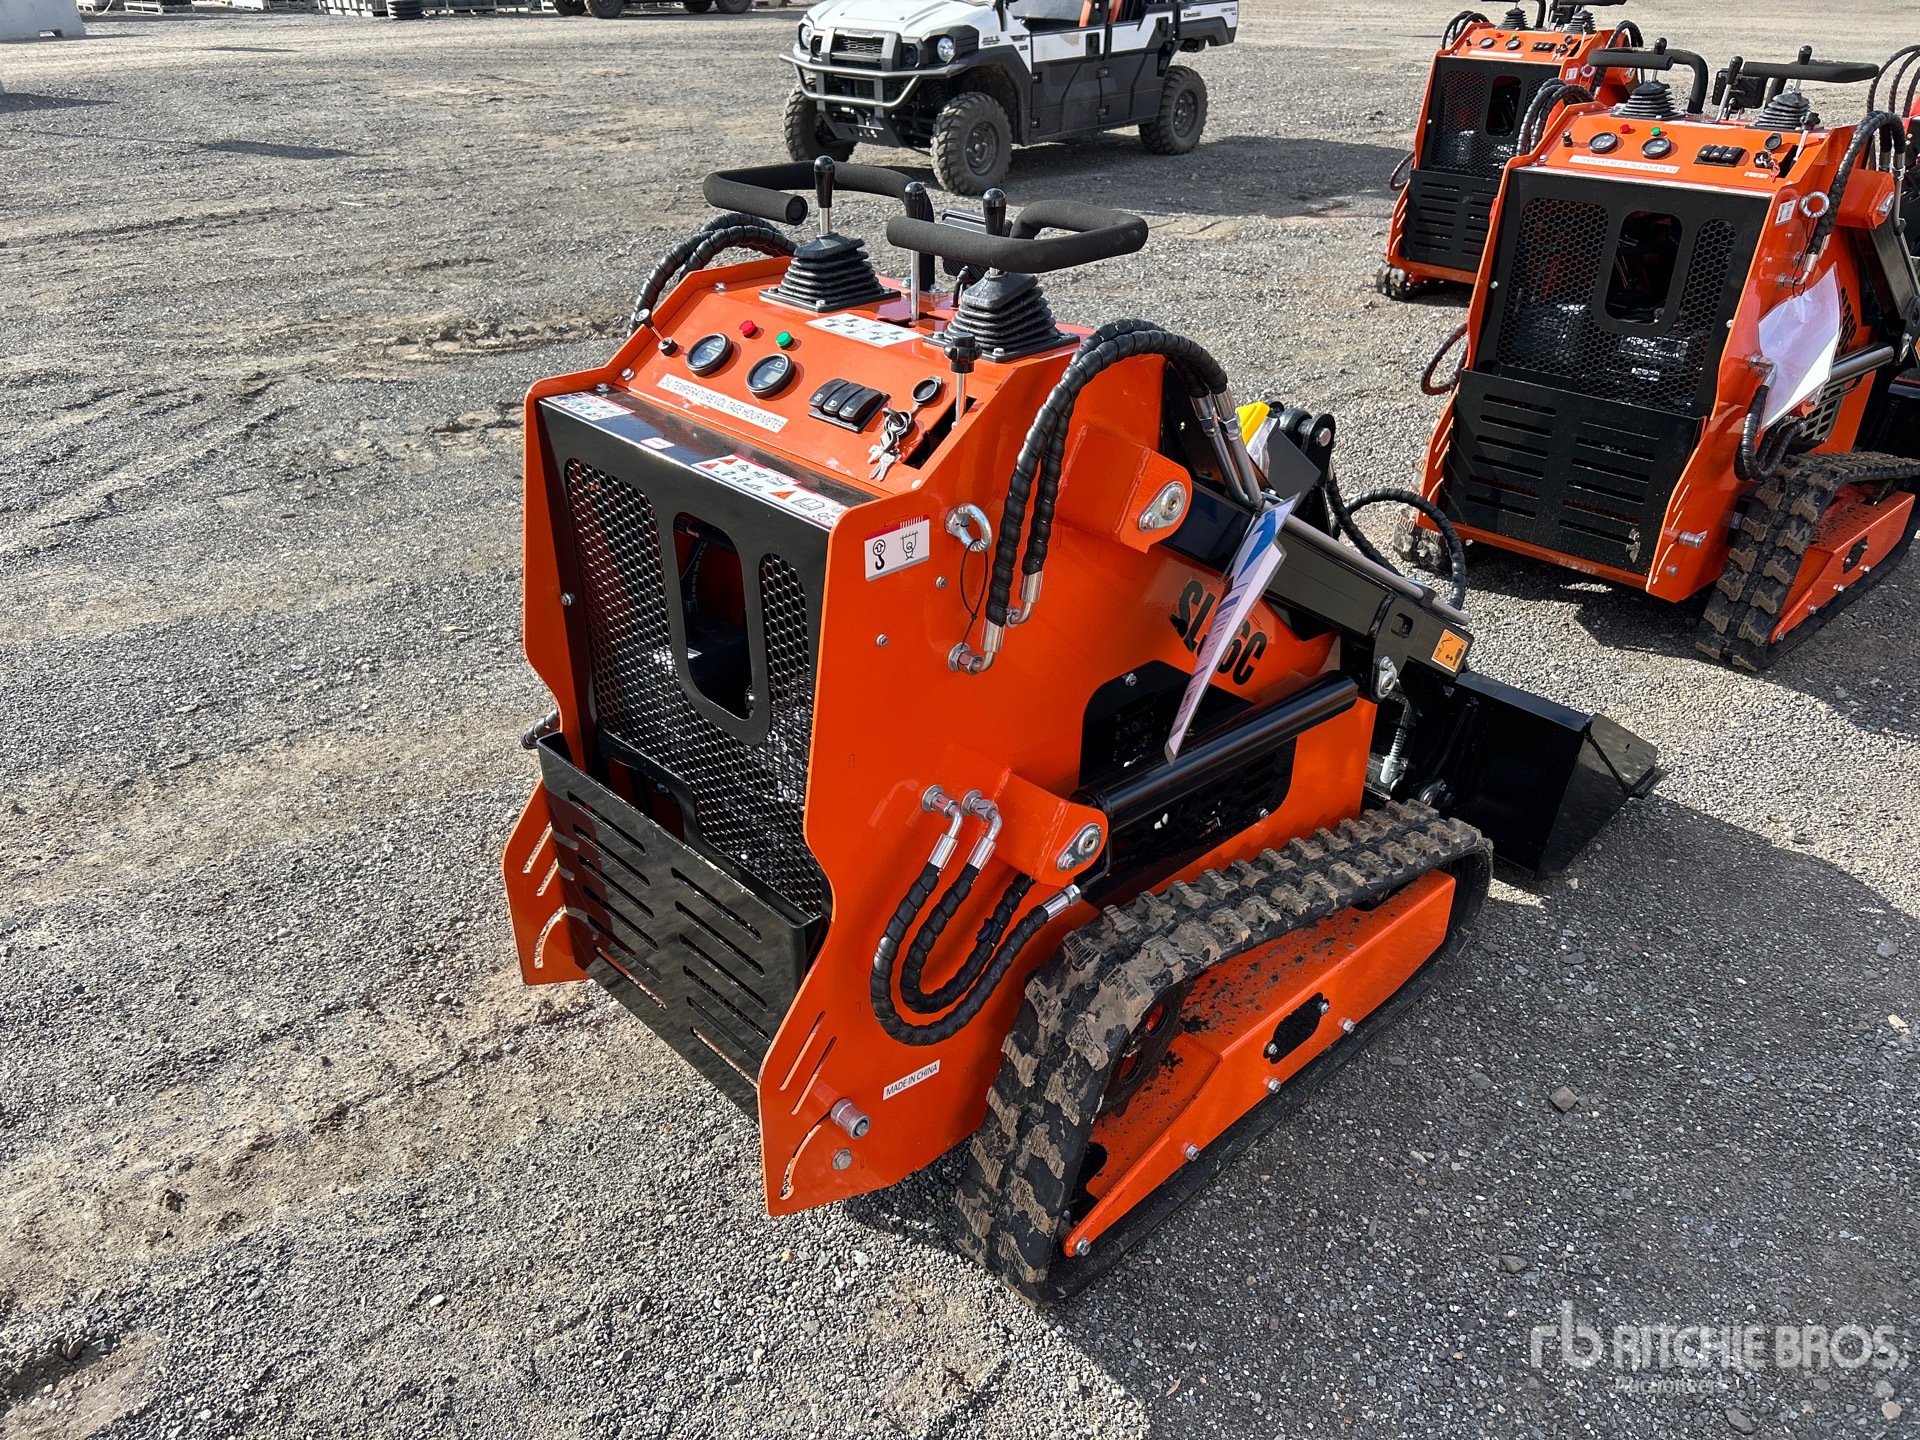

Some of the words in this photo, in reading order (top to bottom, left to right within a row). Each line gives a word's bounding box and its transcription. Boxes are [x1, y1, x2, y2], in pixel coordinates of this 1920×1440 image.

[672, 380, 715, 403] TEMPERATURE
[714, 396, 744, 415] VOLTAGE
[743, 406, 762, 420] HOUR
[761, 414, 785, 430] METER
[1169, 580, 1267, 686] SL6C
[886, 1079, 907, 1096] MADE
[908, 1075, 915, 1084] IN
[917, 1063, 937, 1081] CHINA
